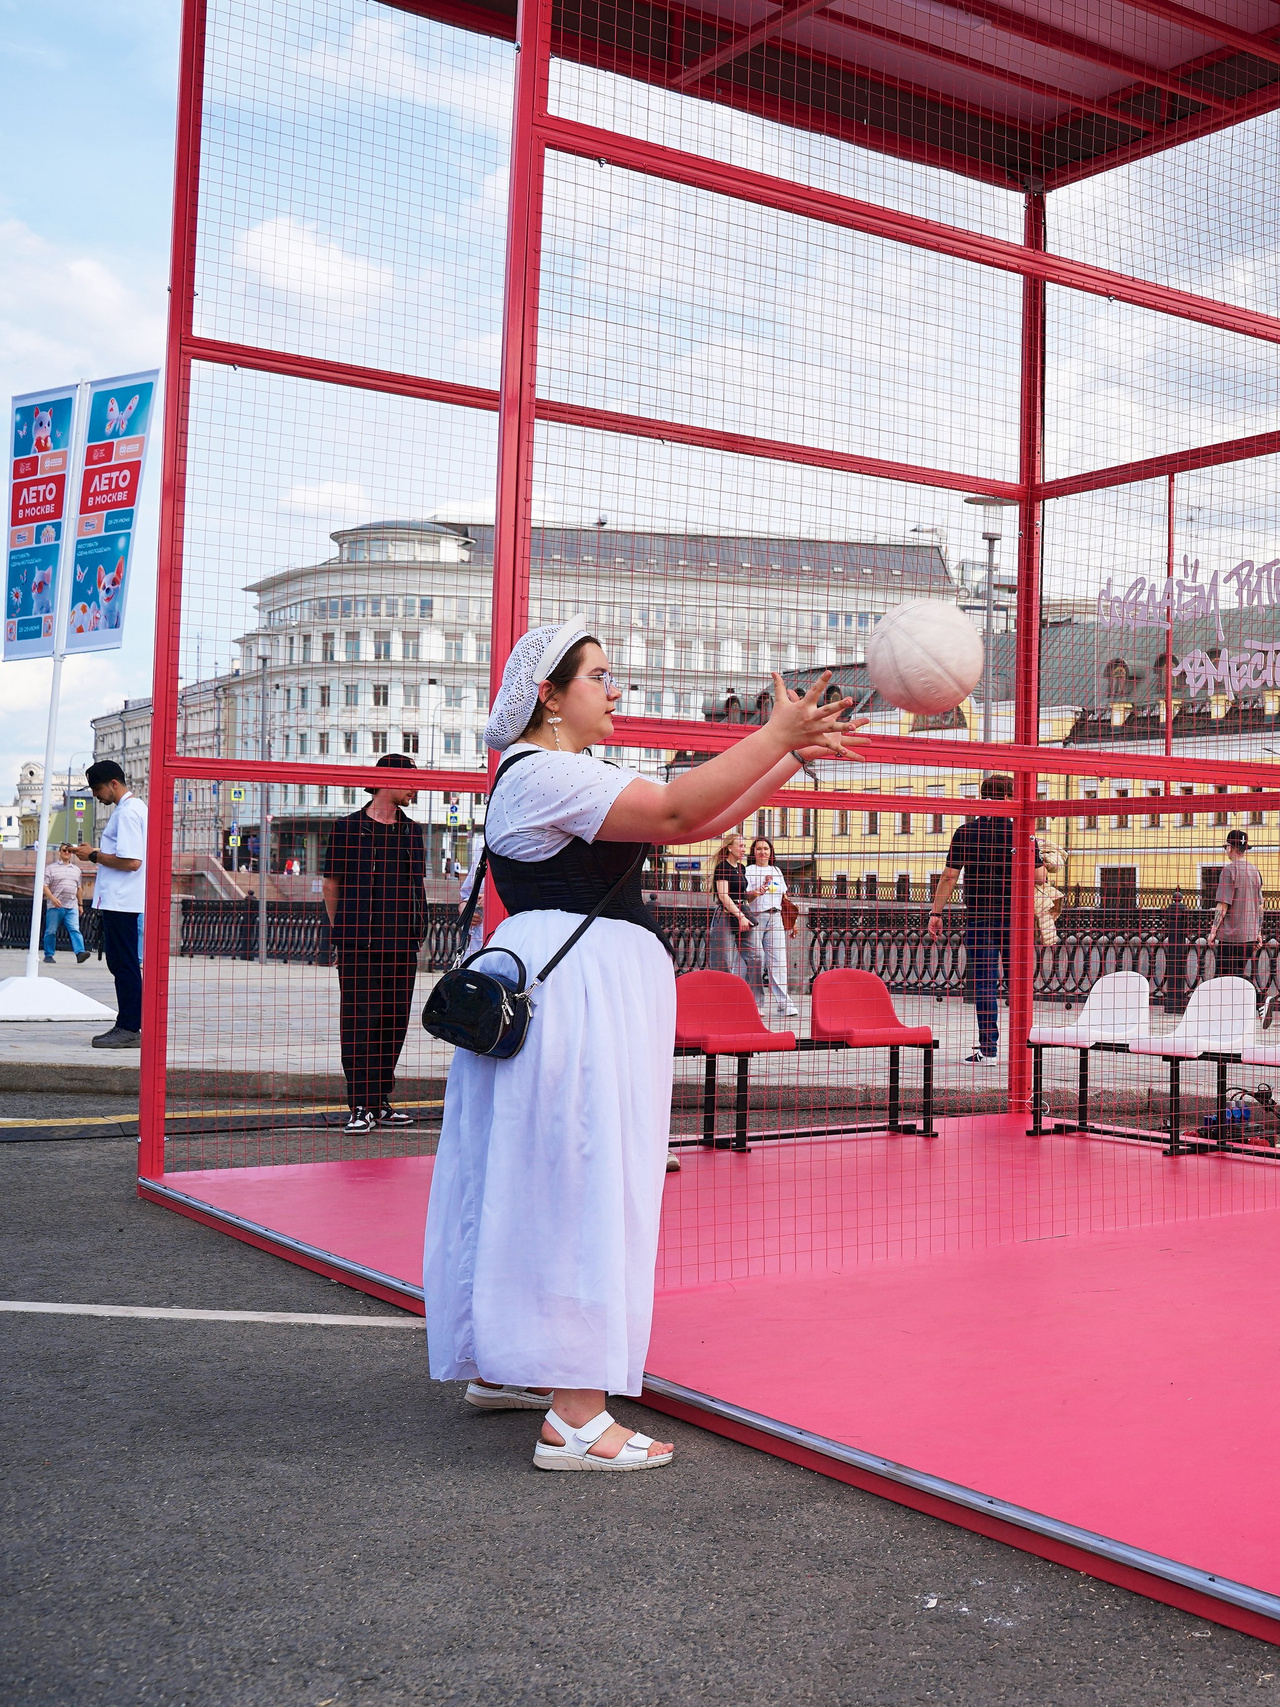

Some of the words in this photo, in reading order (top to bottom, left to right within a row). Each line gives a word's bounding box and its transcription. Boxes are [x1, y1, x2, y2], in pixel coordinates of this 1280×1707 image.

[90, 469, 131, 494] ЛЕТО
[19, 482, 57, 506] ЛЕТО
[88, 496, 94, 506] В
[94, 491, 128, 505] МОСКВЕ
[18, 509, 23, 519] В
[25, 503, 55, 517] МОСКВЕ
